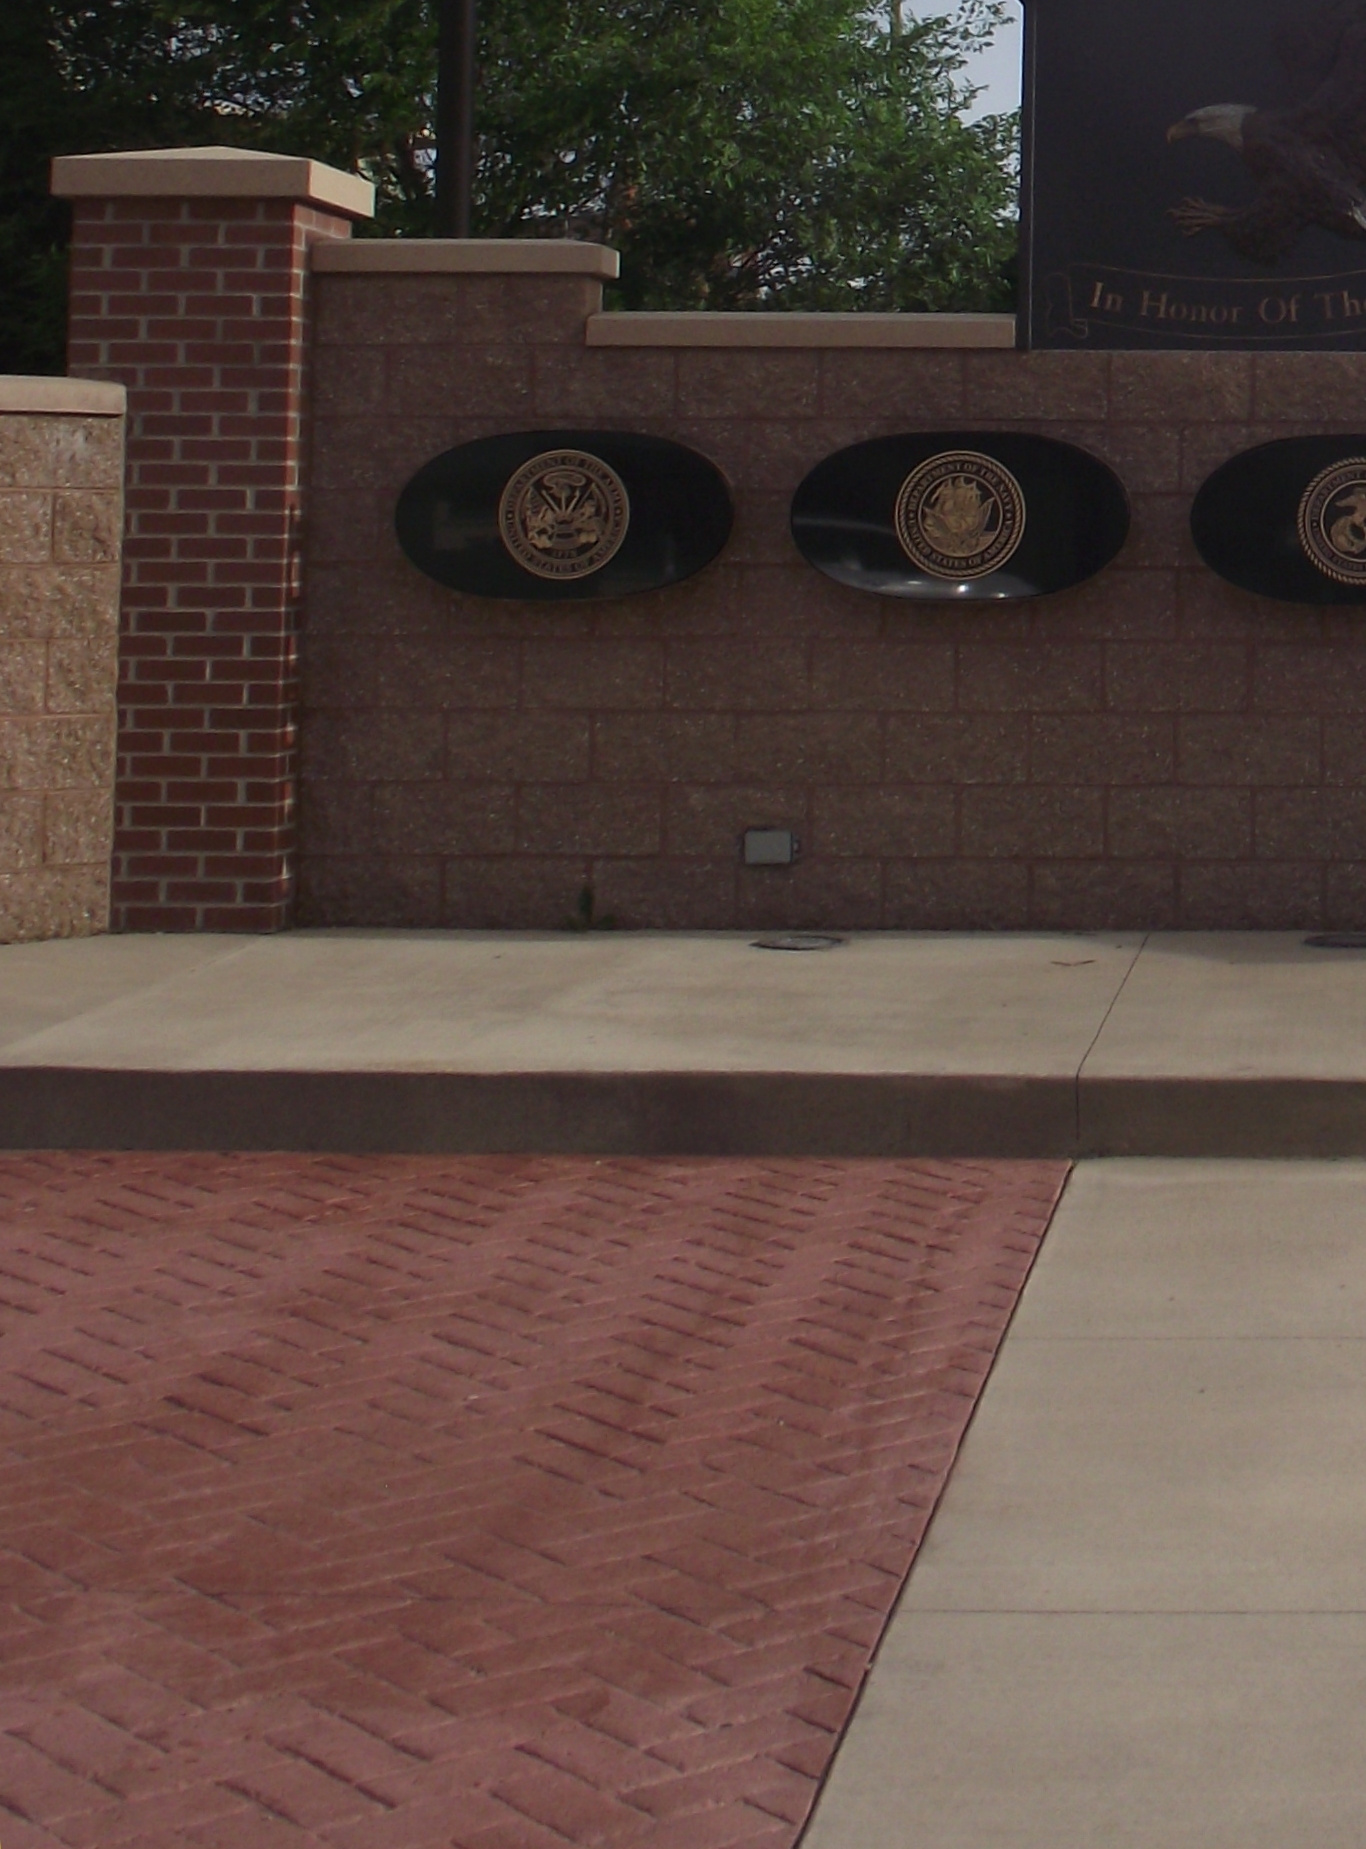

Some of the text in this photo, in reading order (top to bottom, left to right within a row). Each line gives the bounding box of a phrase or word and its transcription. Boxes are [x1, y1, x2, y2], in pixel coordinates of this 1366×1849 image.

[1091, 282, 1123, 312] In
[1140, 290, 1243, 323] Honor
[1258, 294, 1301, 323] Of
[909, 463, 1012, 510] DEPARTMENT OF THE NAVY
[1312, 471, 1360, 519] DEPARTMENT
[931, 553, 968, 567] STATES
